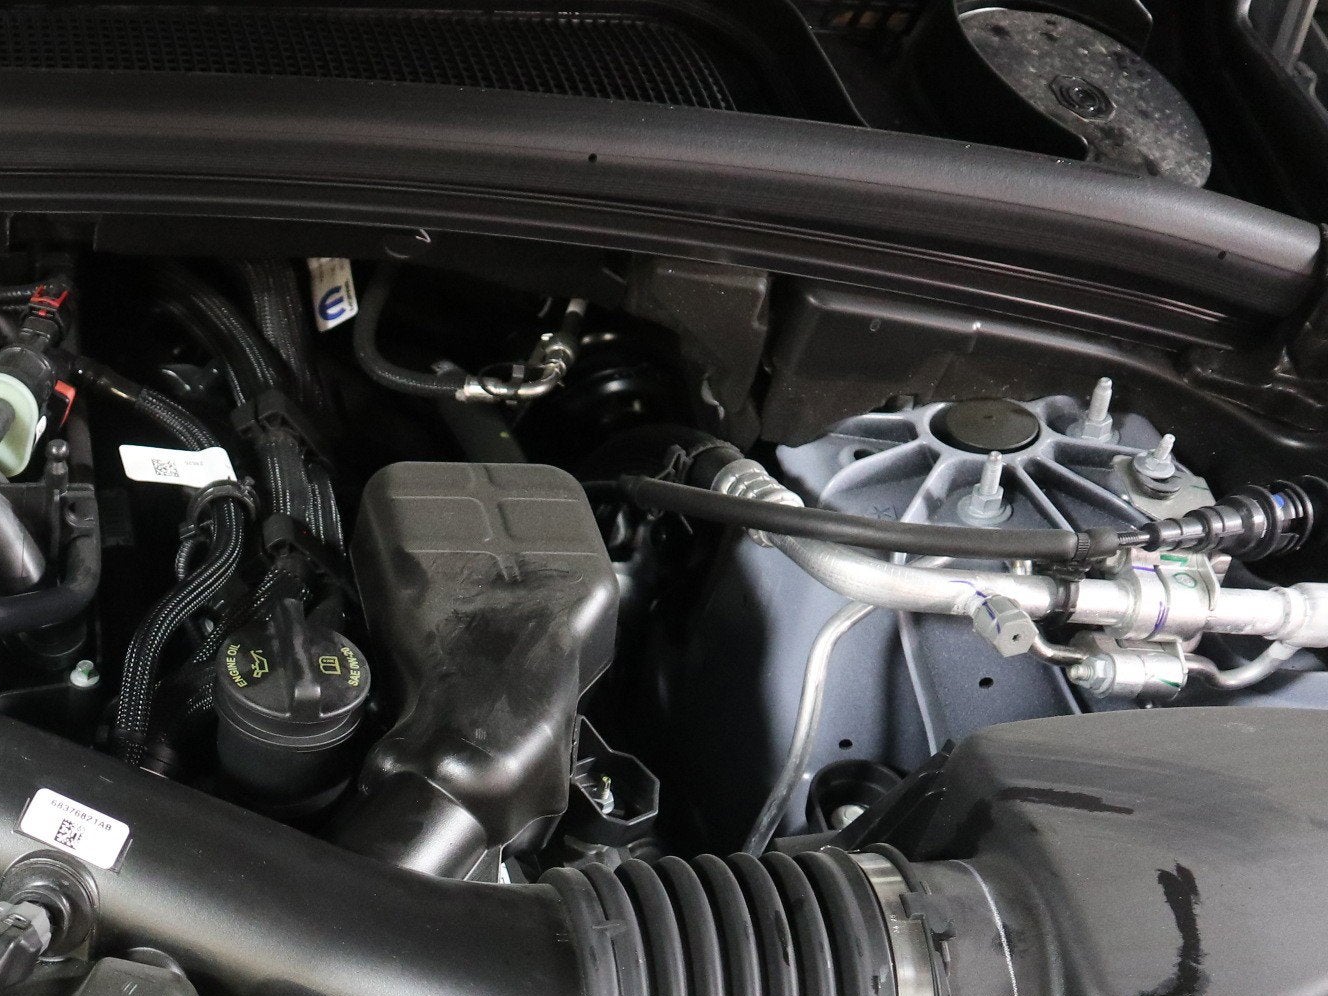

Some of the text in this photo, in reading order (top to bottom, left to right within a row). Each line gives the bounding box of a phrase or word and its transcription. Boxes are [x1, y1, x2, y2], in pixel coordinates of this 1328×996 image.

[226, 644, 248, 687] ENGINE OIL
[341, 647, 361, 687] SAE 0W-20
[50, 799, 112, 832] 68376821AB
